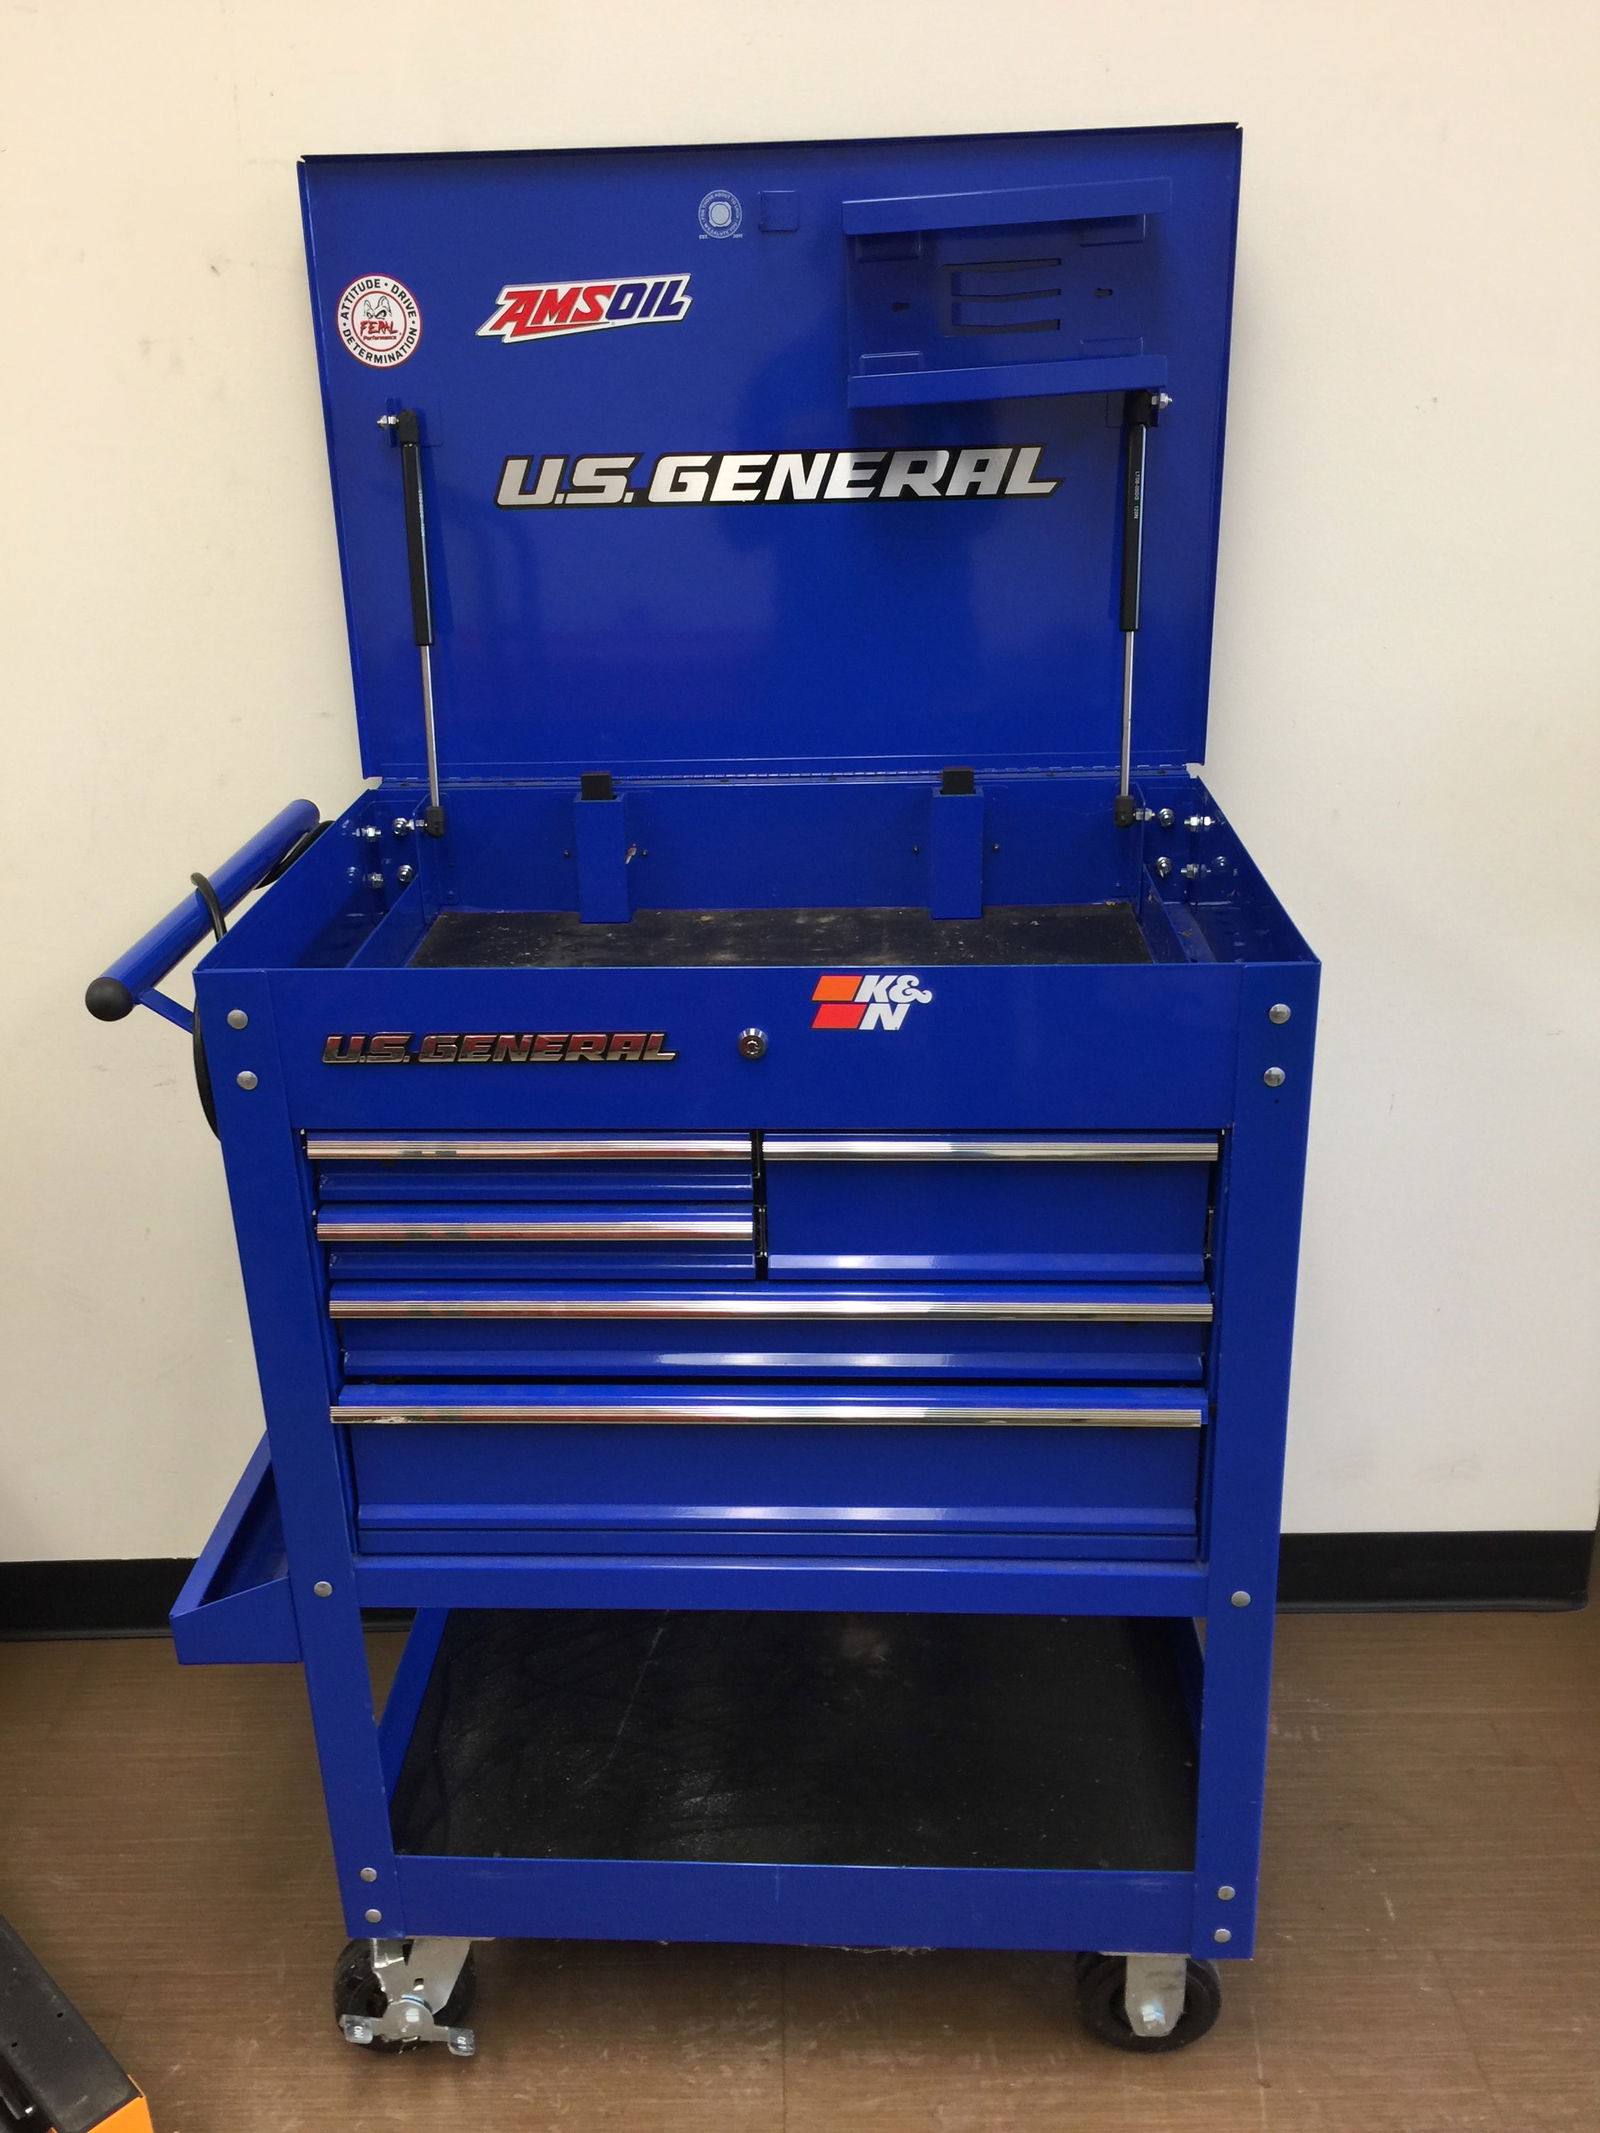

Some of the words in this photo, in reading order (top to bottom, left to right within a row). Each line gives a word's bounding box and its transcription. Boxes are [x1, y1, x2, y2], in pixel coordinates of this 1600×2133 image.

[341, 278, 381, 320] ATTITUDE
[391, 284, 417, 318] DRIVE
[488, 279, 685, 338] AMSOIL
[342, 327, 418, 364] DETERMINATION
[648, 446, 1059, 503] GENERAL
[418, 1032, 677, 1063] GENERAL
